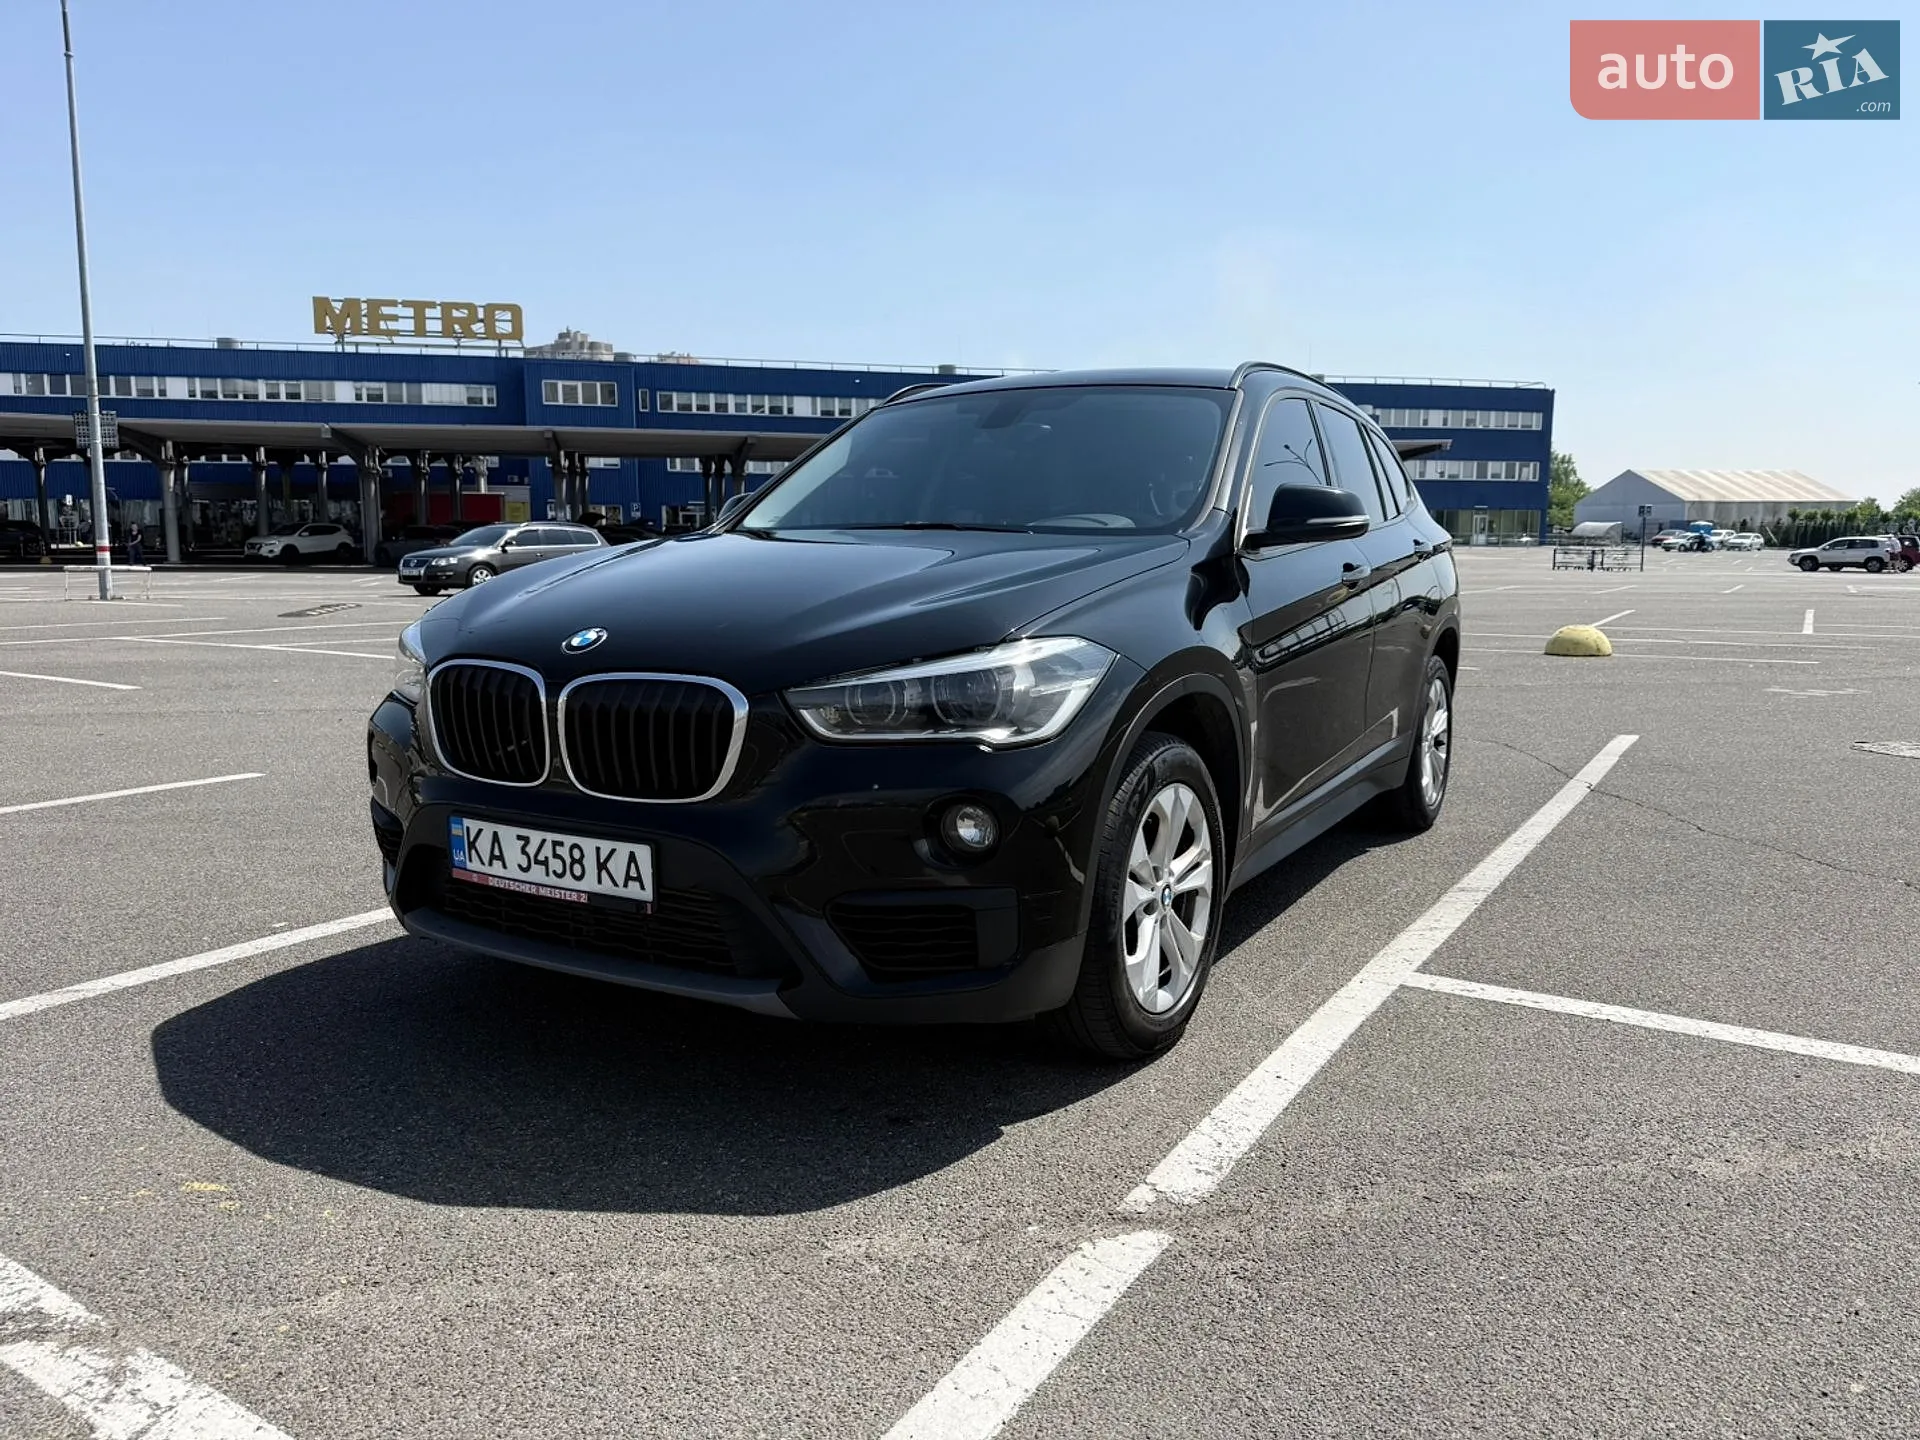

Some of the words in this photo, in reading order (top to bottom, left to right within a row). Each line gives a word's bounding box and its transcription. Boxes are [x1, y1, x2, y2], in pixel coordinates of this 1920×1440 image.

[312, 296, 524, 340] METRO
[453, 849, 465, 861] UA
[466, 825, 508, 870] KA
[516, 834, 586, 882] 3458
[595, 846, 646, 891] KA
[487, 876, 537, 894] DEUTSCHER
[539, 885, 578, 901] MEISTER
